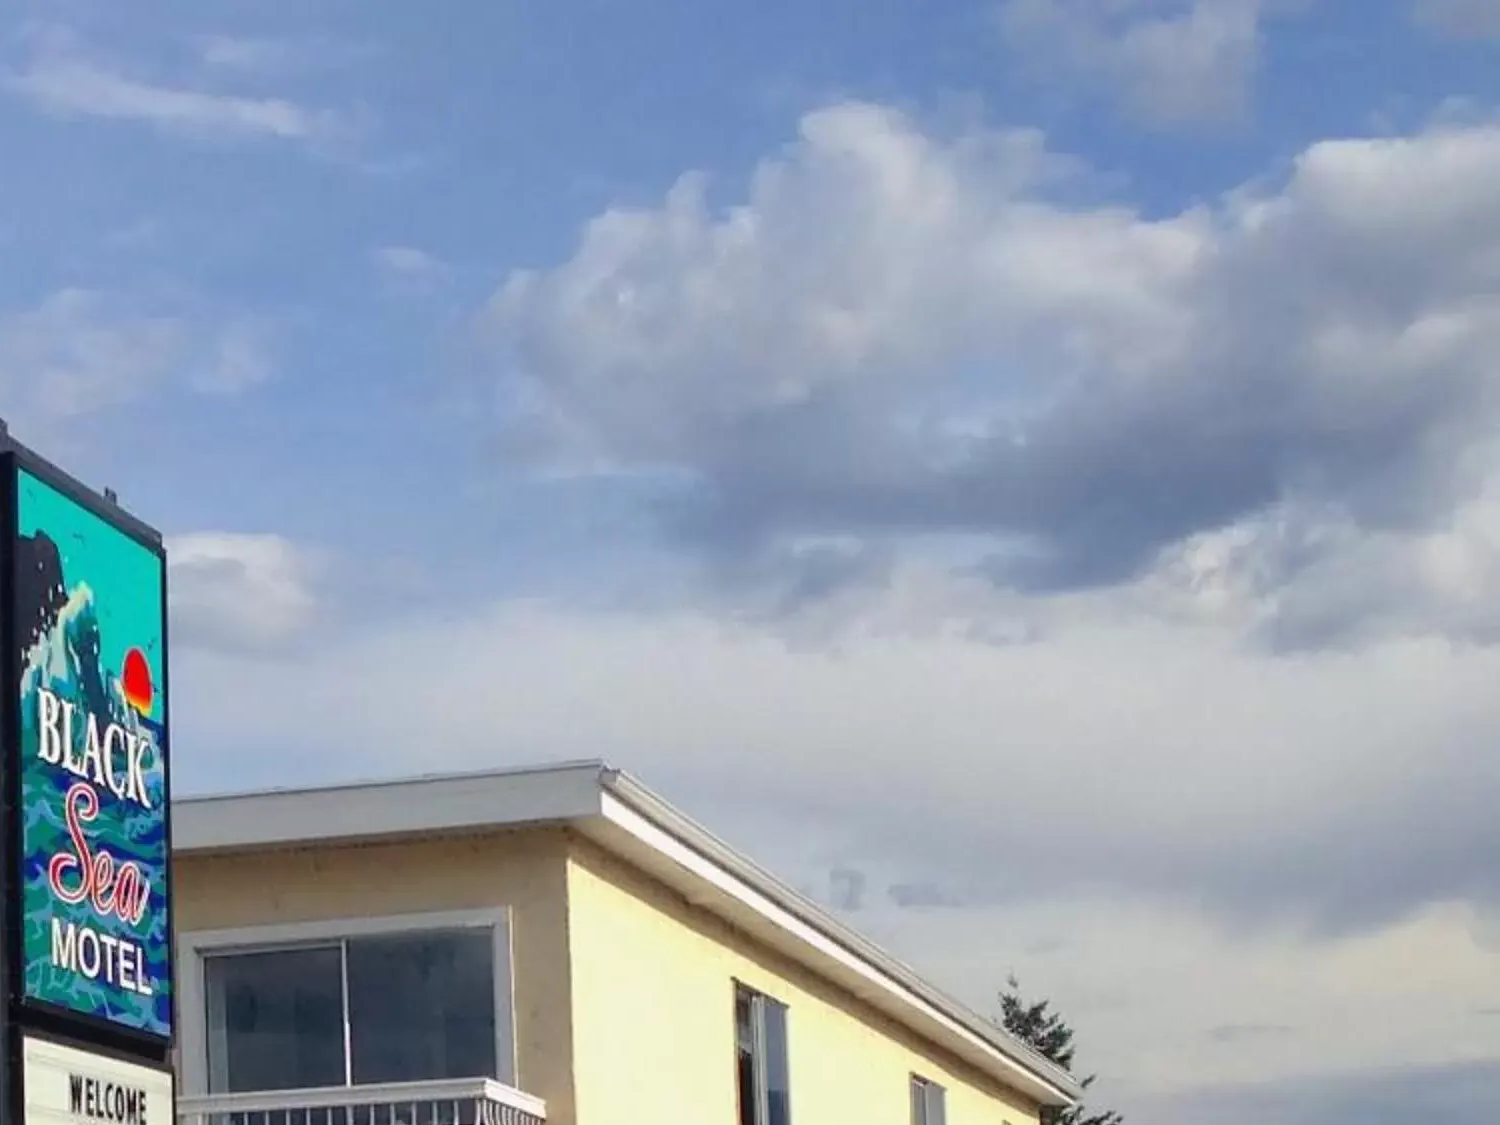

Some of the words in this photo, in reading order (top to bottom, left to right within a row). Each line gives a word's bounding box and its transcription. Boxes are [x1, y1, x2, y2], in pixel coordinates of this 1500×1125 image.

[37, 686, 151, 808] BLACK
[49, 783, 151, 926] Sea
[51, 917, 153, 995] MOTEL
